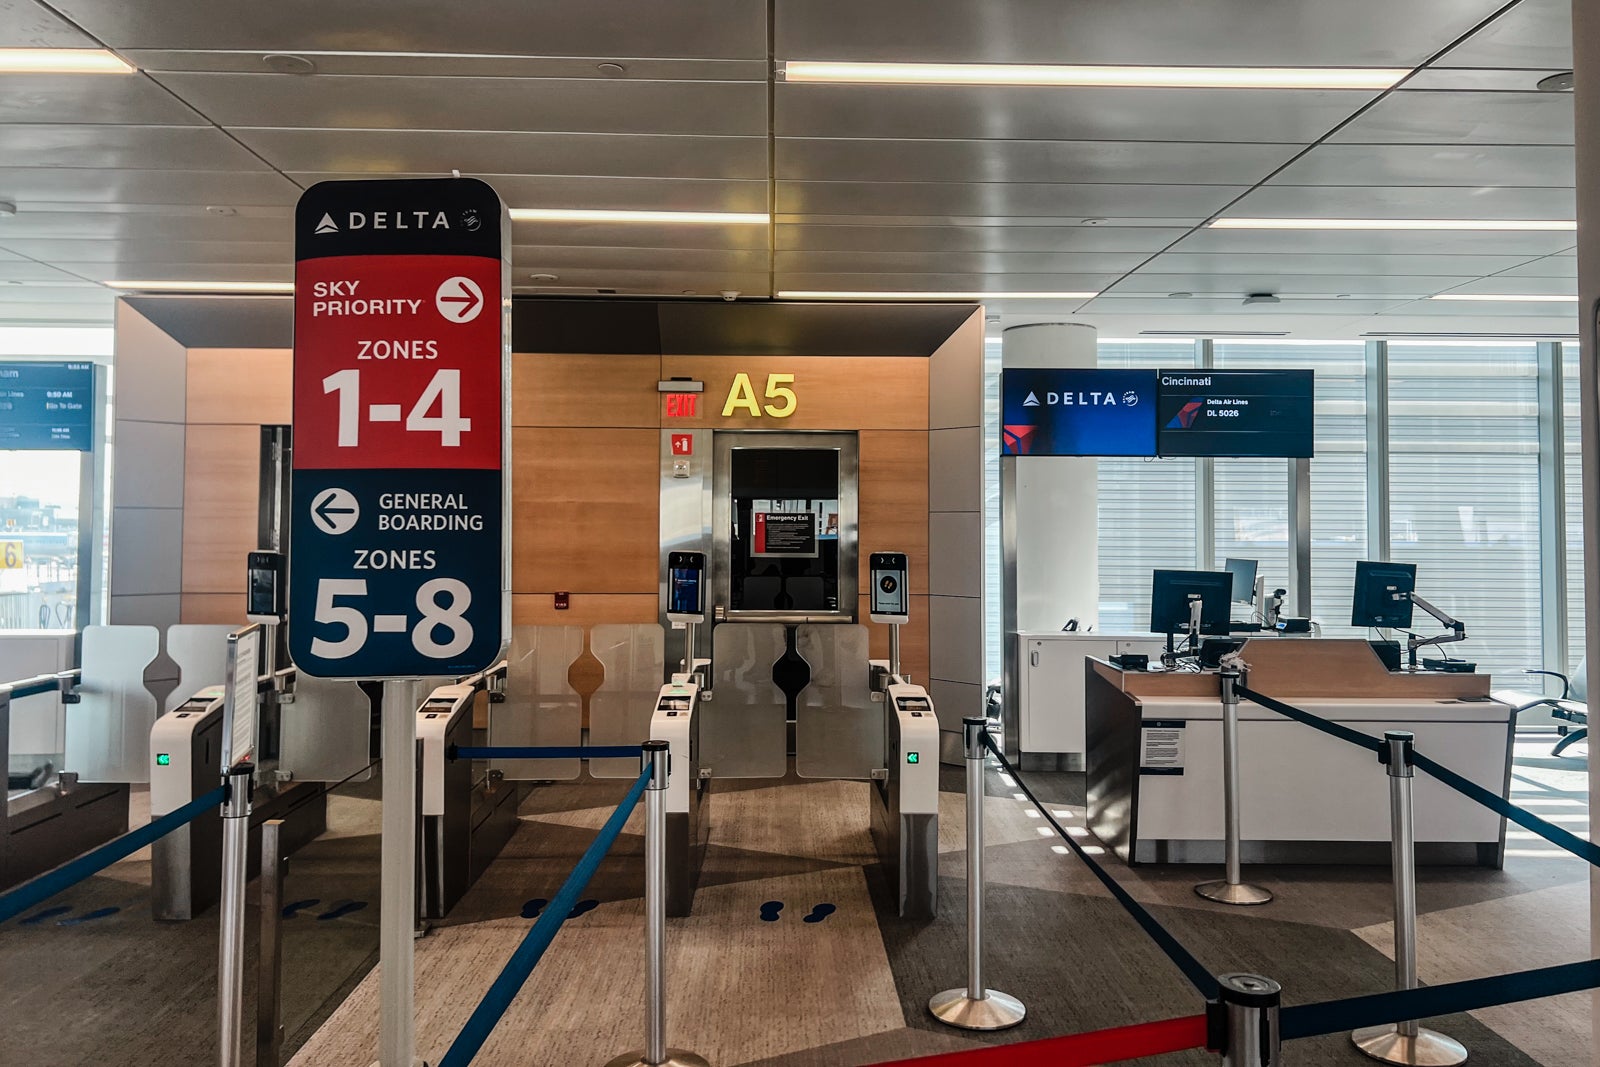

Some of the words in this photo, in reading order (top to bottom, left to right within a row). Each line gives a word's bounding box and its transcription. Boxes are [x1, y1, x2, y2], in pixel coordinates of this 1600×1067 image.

[349, 211, 450, 230] DELTA
[313, 280, 360, 298] SKY
[313, 299, 423, 317] PRIORITY
[357, 340, 438, 360] ZONES
[1161, 376, 1212, 386] Cincinnati
[721, 372, 797, 418] A5
[1046, 391, 1117, 406] DELTA
[322, 368, 472, 447] 1-4
[666, 393, 697, 417] EXIT
[379, 493, 468, 510] GENERAL
[378, 514, 484, 531] BOARDING
[5, 542, 17, 568] 6
[353, 549, 437, 570] ZONES
[310, 577, 474, 659] 5-8
